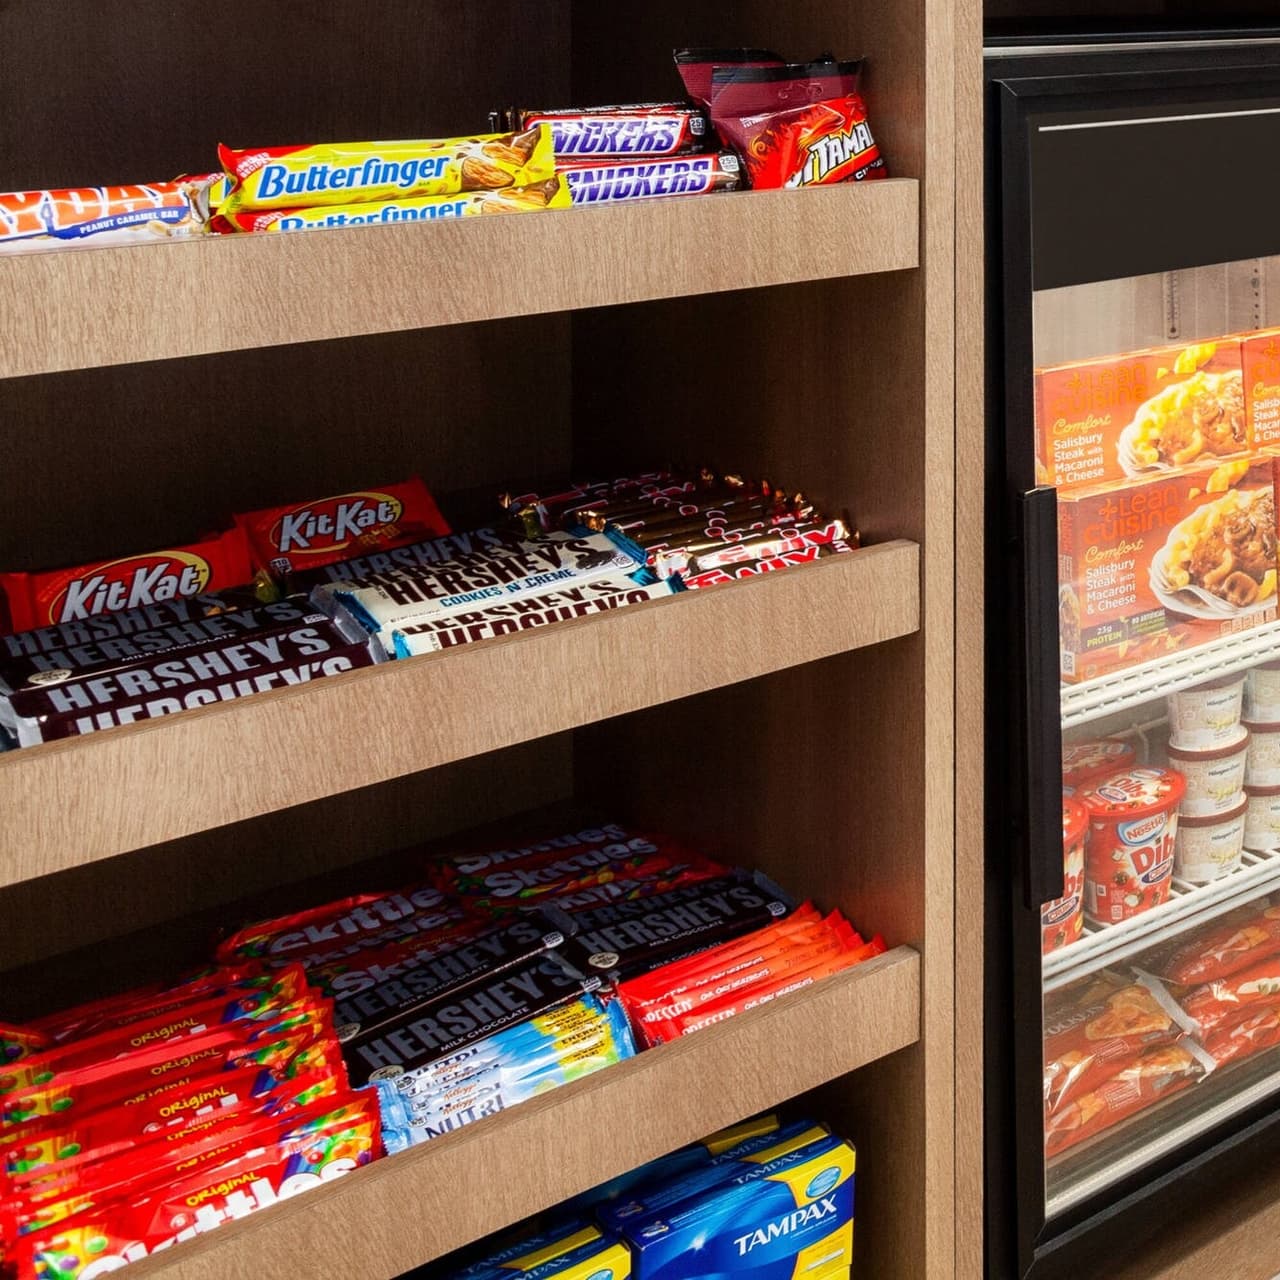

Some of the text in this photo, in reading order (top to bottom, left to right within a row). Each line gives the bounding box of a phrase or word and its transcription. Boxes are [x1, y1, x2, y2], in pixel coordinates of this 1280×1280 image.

[552, 118, 681, 155] NICKERS
[257, 156, 450, 199] Butterfinger
[80, 210, 179, 235] PEANUT CARAMEL BAR
[1052, 413, 1112, 436] Comfort
[1253, 408, 1279, 422] Steak
[1053, 431, 1104, 451] Salisbury
[1053, 448, 1085, 463] Steak
[1054, 455, 1104, 474] Macaroni
[1066, 466, 1105, 483] Cheese
[1119, 483, 1180, 517] Lean
[278, 499, 400, 553] KitKat
[1084, 505, 1180, 545] cuisine
[1085, 537, 1144, 564] Comfort
[383, 539, 598, 606] HERSHEY'S
[1085, 558, 1136, 580] Salisbury
[1086, 576, 1117, 592] Steak
[59, 562, 203, 625] KitKat
[439, 567, 576, 609] COOKIES CREME
[1086, 582, 1136, 603] Macaroni
[1097, 594, 1137, 613] Cheese
[1086, 631, 1123, 649] PROTEIN
[576, 886, 766, 956] HERSHEY'S
[130, 1018, 200, 1048] ORIGINAL
[440, 1007, 531, 1053] MILK CHOCOLATE
[159, 1085, 230, 1118] ORIGINAL
[424, 1094, 506, 1140] NUTRI
[733, 1151, 805, 1187] TAMPAX
[184, 1172, 261, 1207] ORIGINAL
[732, 1193, 839, 1257] TAMPAX
